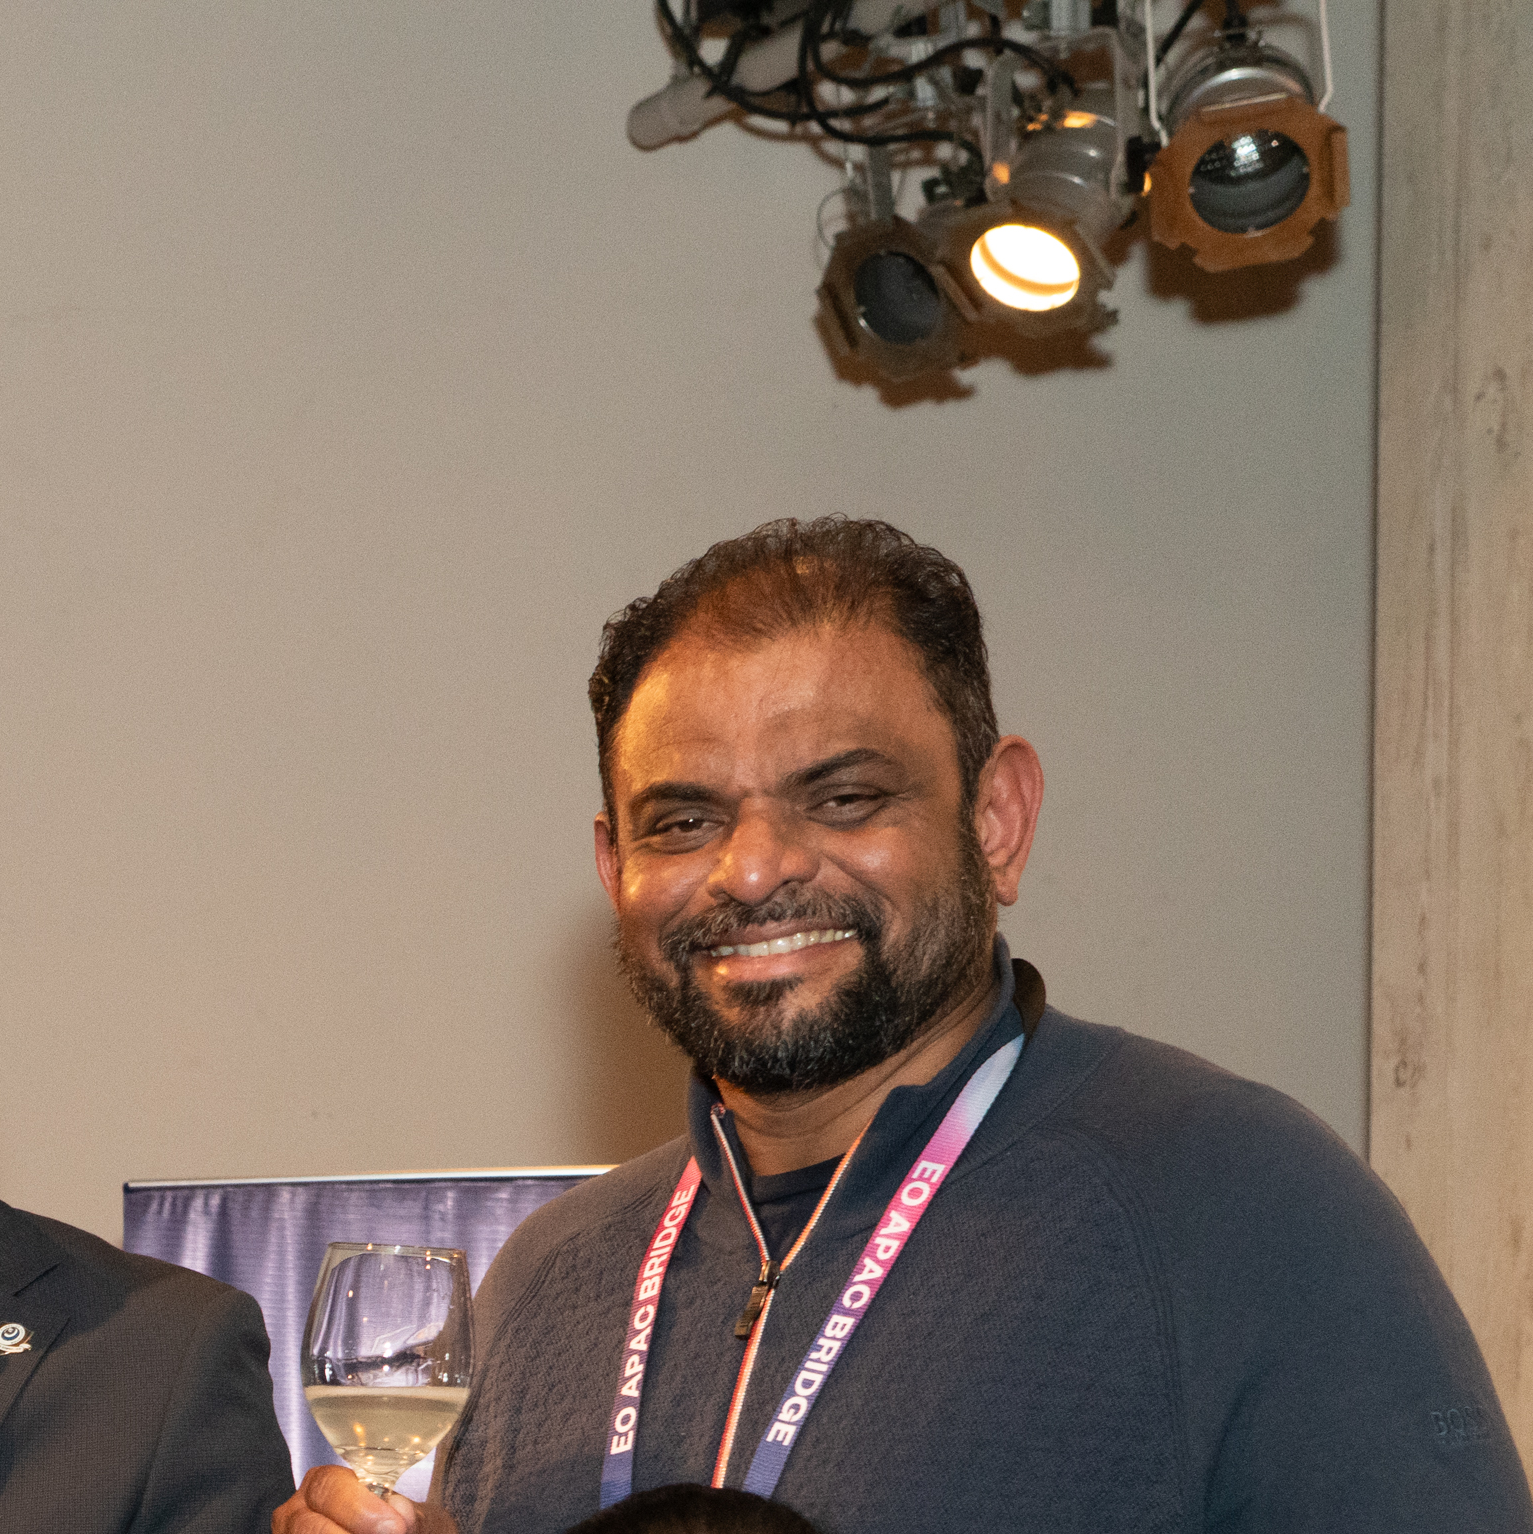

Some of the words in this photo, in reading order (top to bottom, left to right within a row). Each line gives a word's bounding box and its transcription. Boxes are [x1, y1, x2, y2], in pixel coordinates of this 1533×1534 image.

[900, 1159, 946, 1208] EO
[638, 1184, 696, 1303] BRIDGE
[841, 1209, 911, 1311] APAC
[620, 1302, 655, 1399] APAC
[765, 1315, 855, 1447] BRIDGE
[609, 1405, 638, 1456] EO
